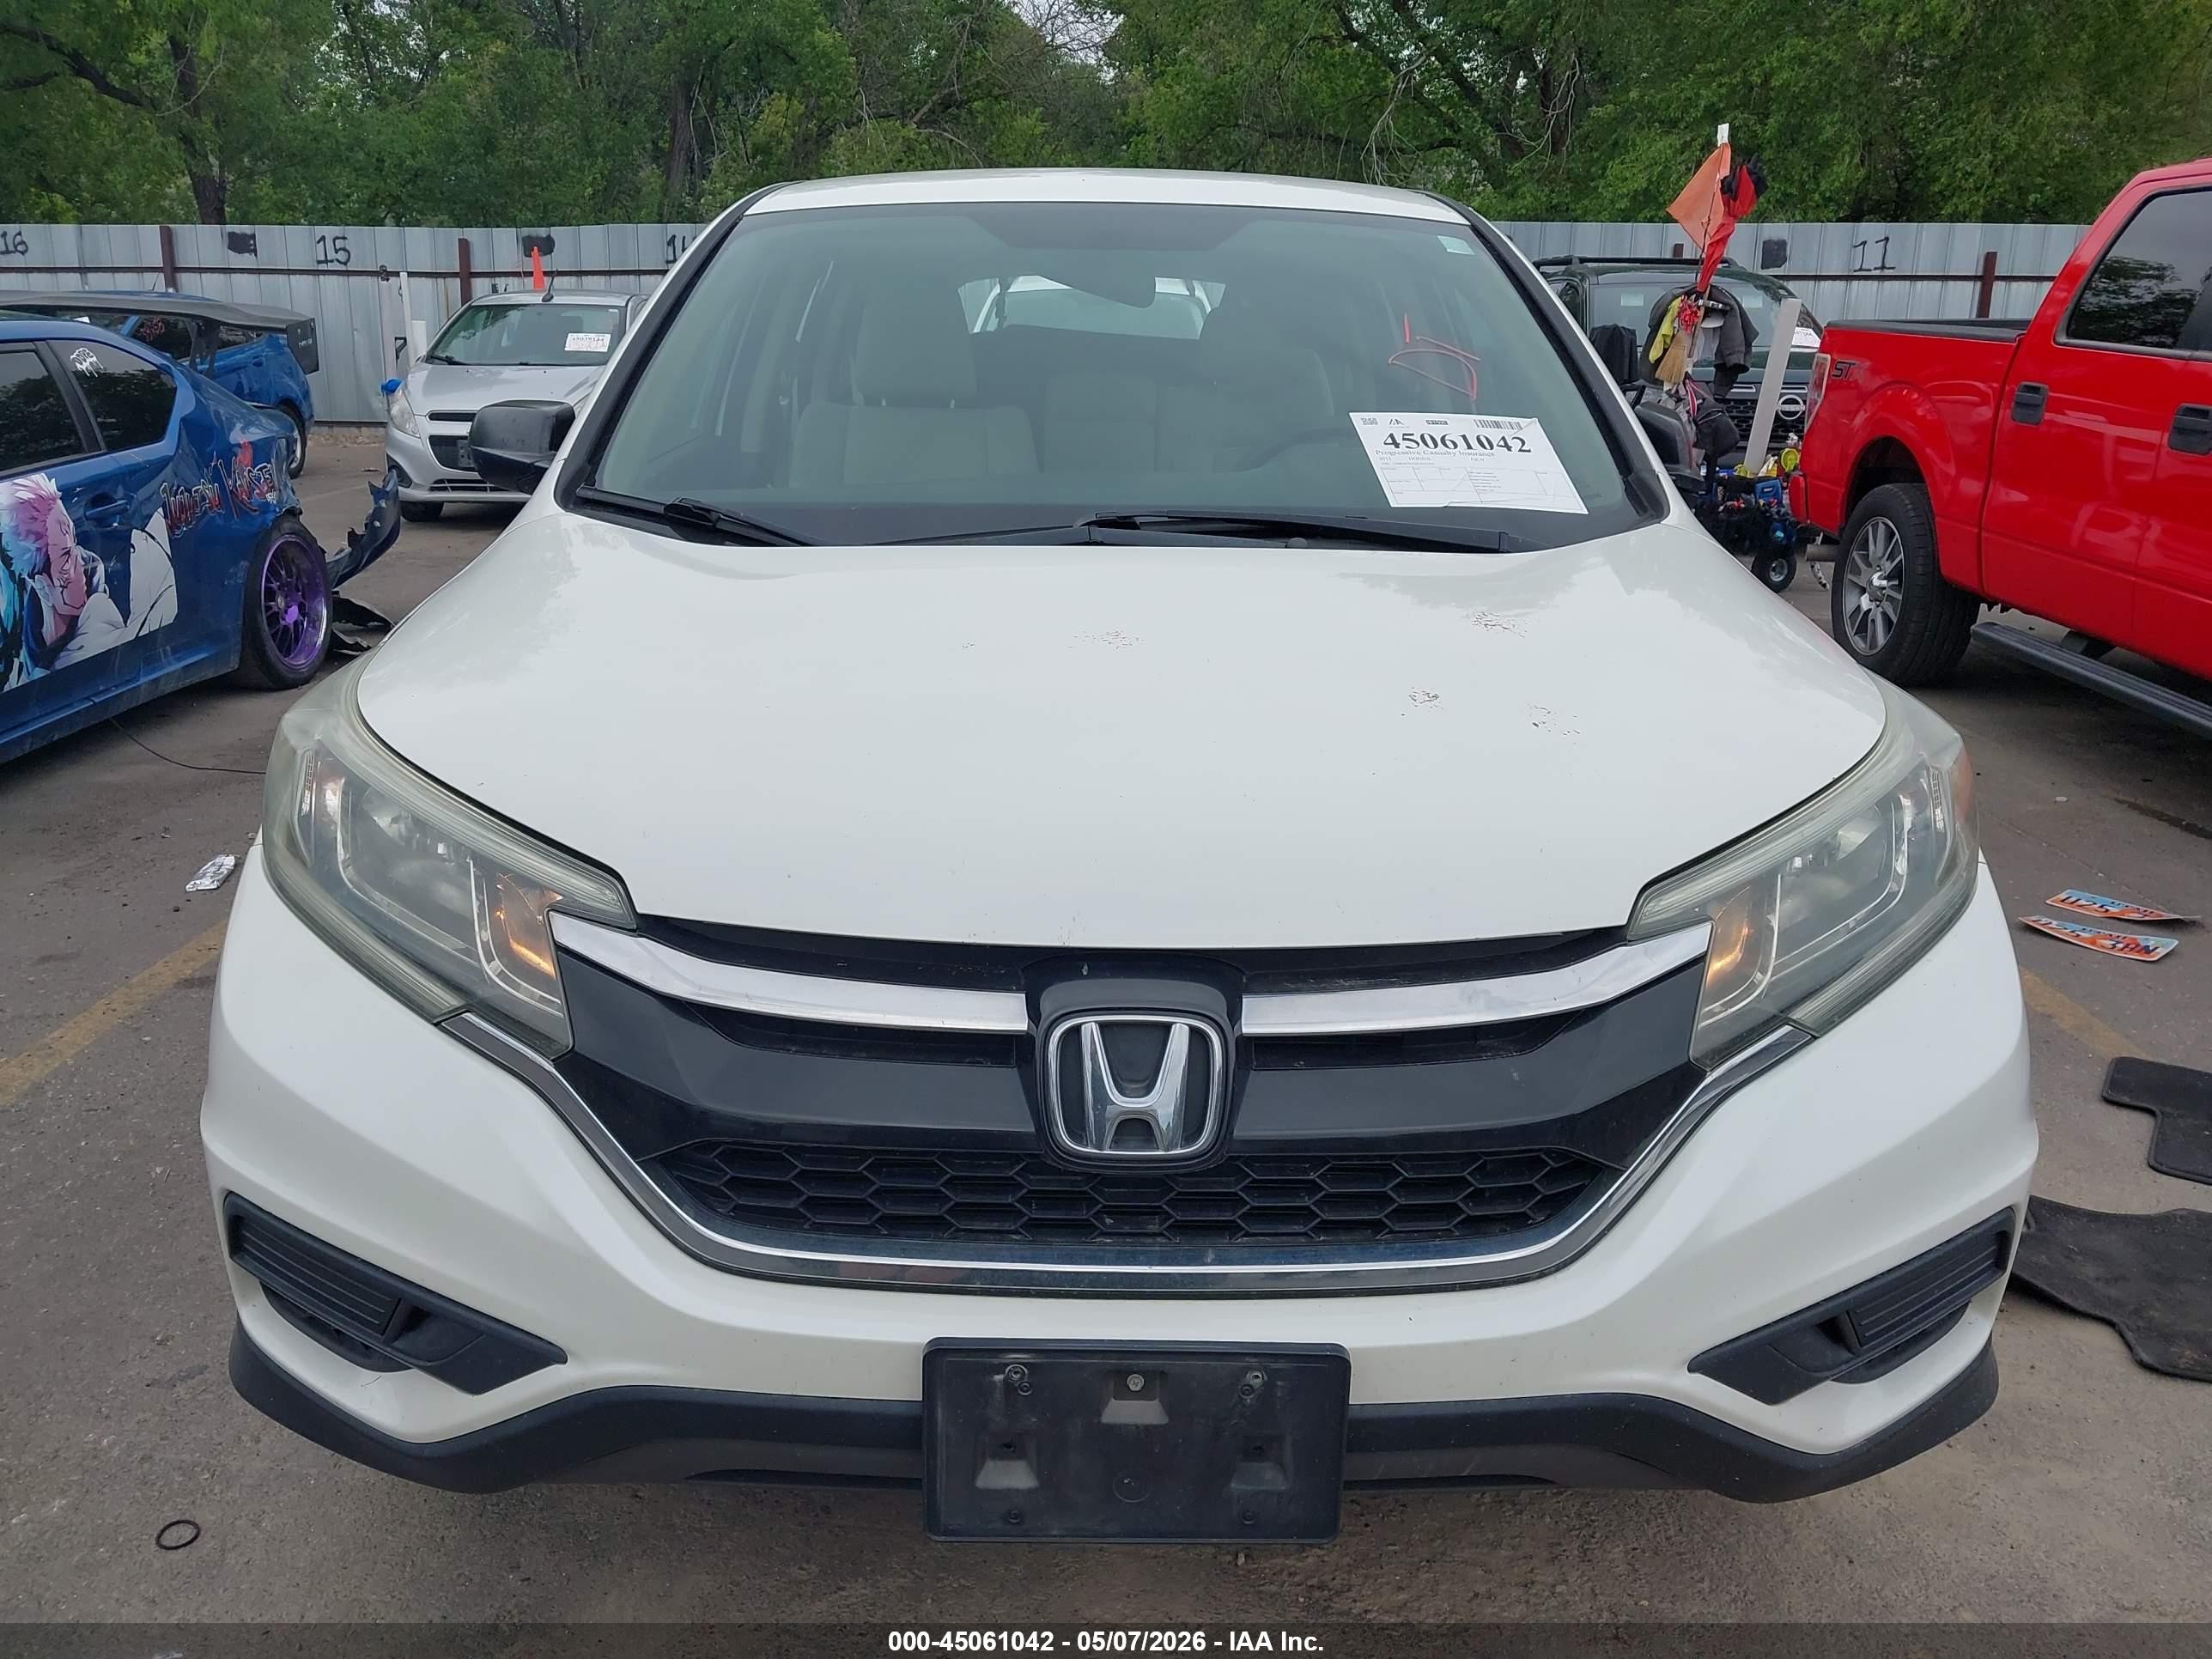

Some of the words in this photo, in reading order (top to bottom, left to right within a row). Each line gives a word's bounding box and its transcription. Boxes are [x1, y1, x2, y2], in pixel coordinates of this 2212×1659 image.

[0, 230, 29, 256] 16
[316, 234, 351, 268] 15
[1852, 236, 1897, 272] 11
[1382, 432, 1532, 453] 45061042
